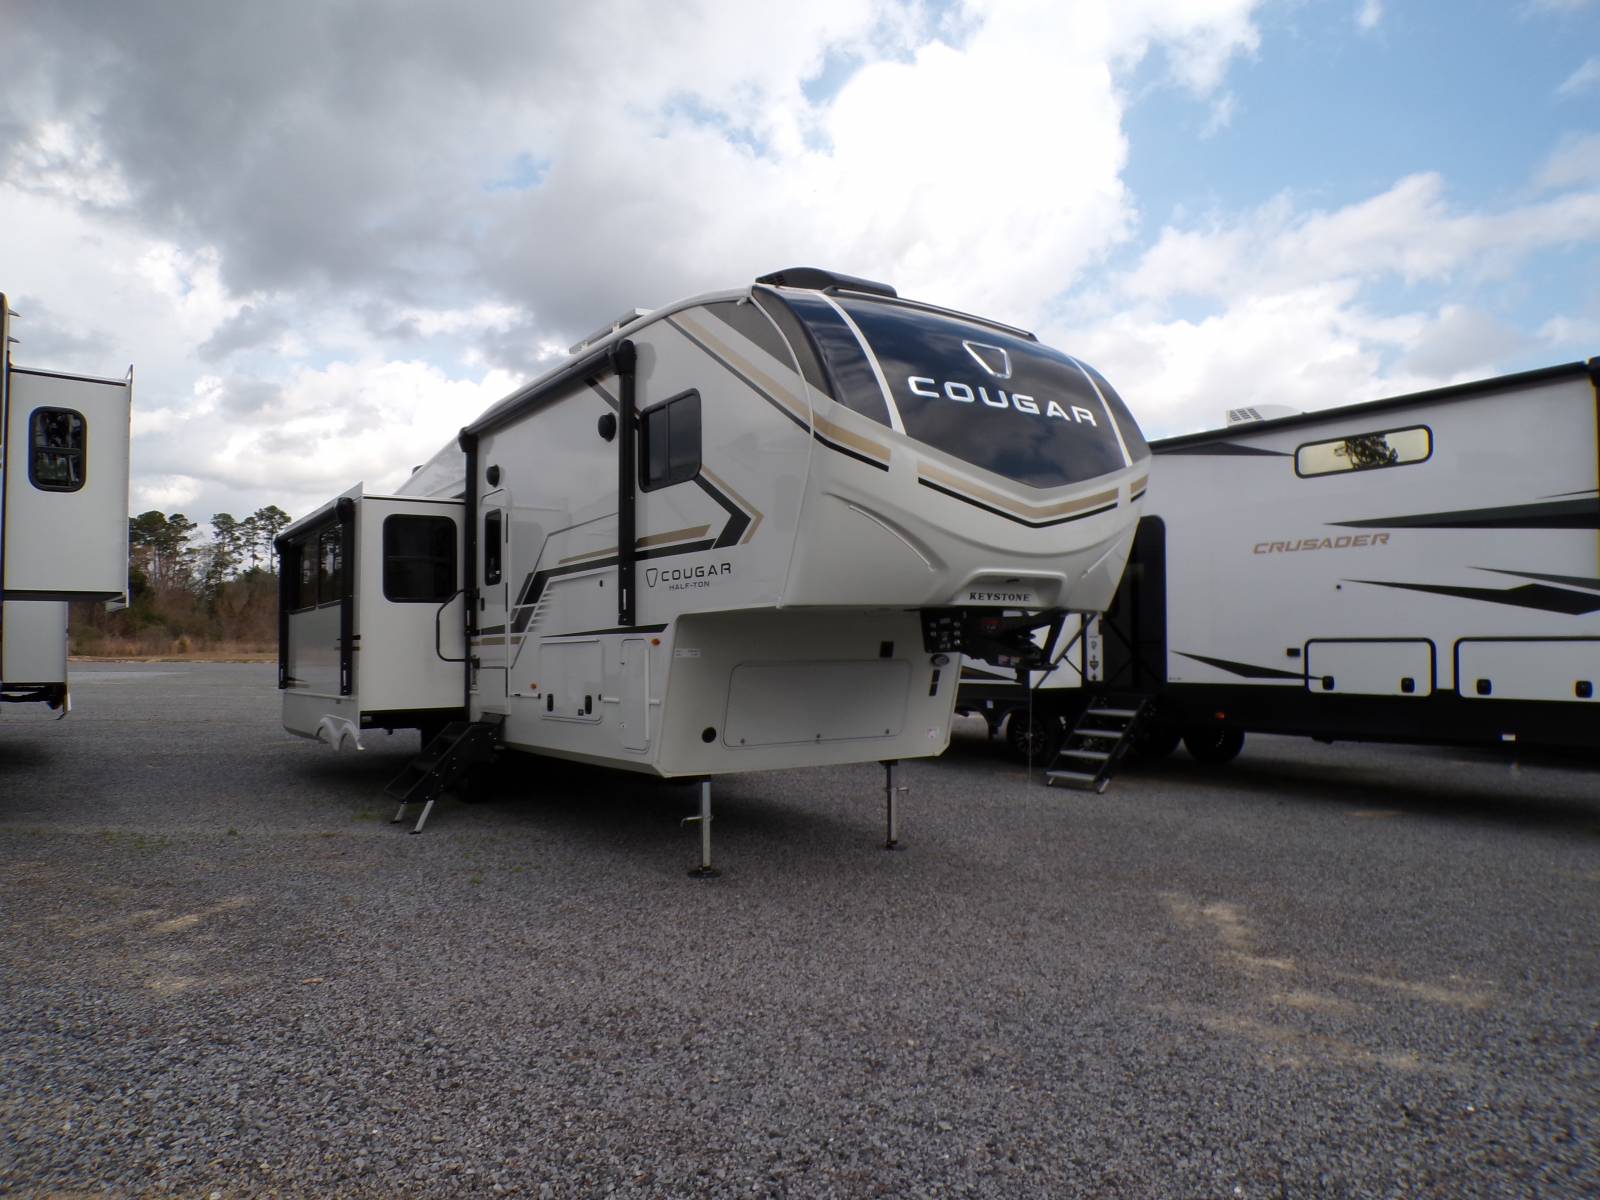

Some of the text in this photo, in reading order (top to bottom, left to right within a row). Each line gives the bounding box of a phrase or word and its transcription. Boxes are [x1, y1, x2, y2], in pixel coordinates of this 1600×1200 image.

[907, 375, 1098, 428] COUGAR
[1253, 533, 1391, 555] CRUSADER
[661, 562, 732, 582] COUGAR
[669, 580, 710, 591] HALF-TON
[969, 592, 1031, 602] KEYSTONE
